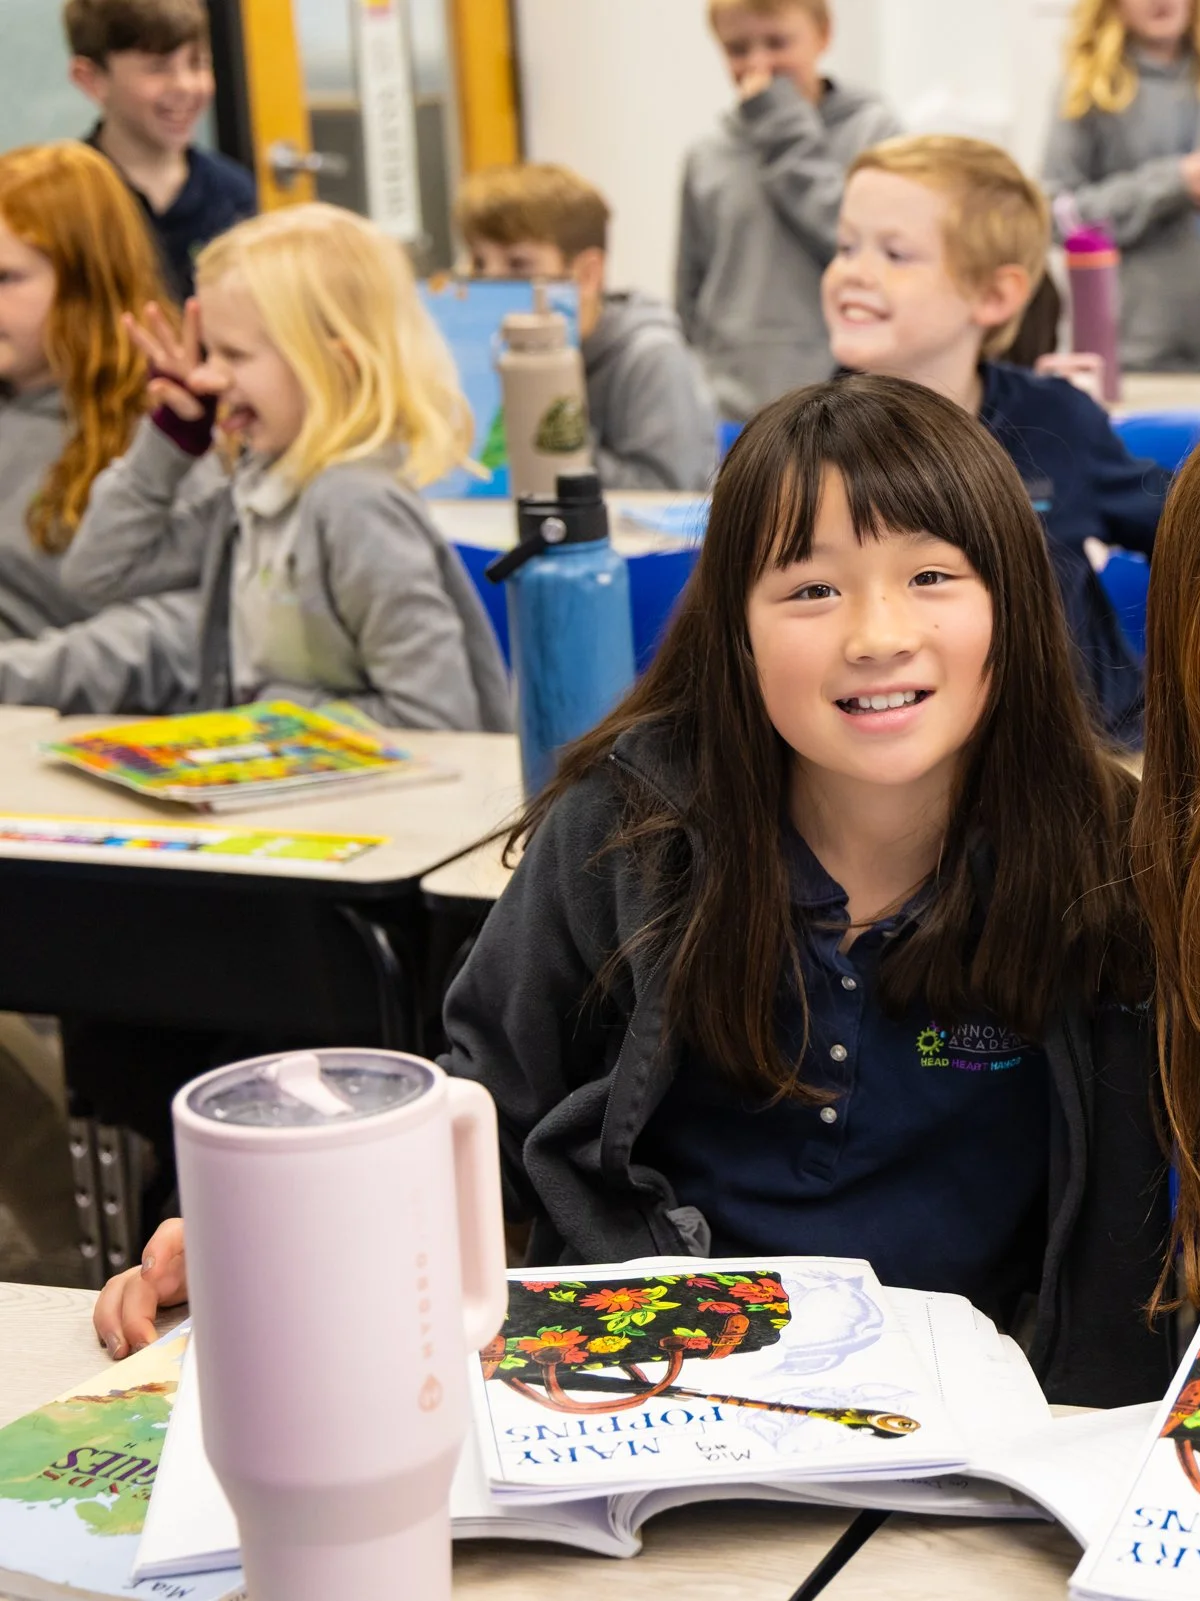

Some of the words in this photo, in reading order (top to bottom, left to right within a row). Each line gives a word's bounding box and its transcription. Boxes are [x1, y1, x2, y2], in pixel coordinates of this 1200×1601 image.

[951, 1023, 1008, 1039] INNOV
[920, 1057, 950, 1067] HEAD
[952, 1058, 988, 1071] HEART
[504, 1406, 724, 1443] POPPINS
[516, 1437, 660, 1466] MARY
[703, 1449, 750, 1461] Mia
[152, 1582, 196, 1598] Mia
